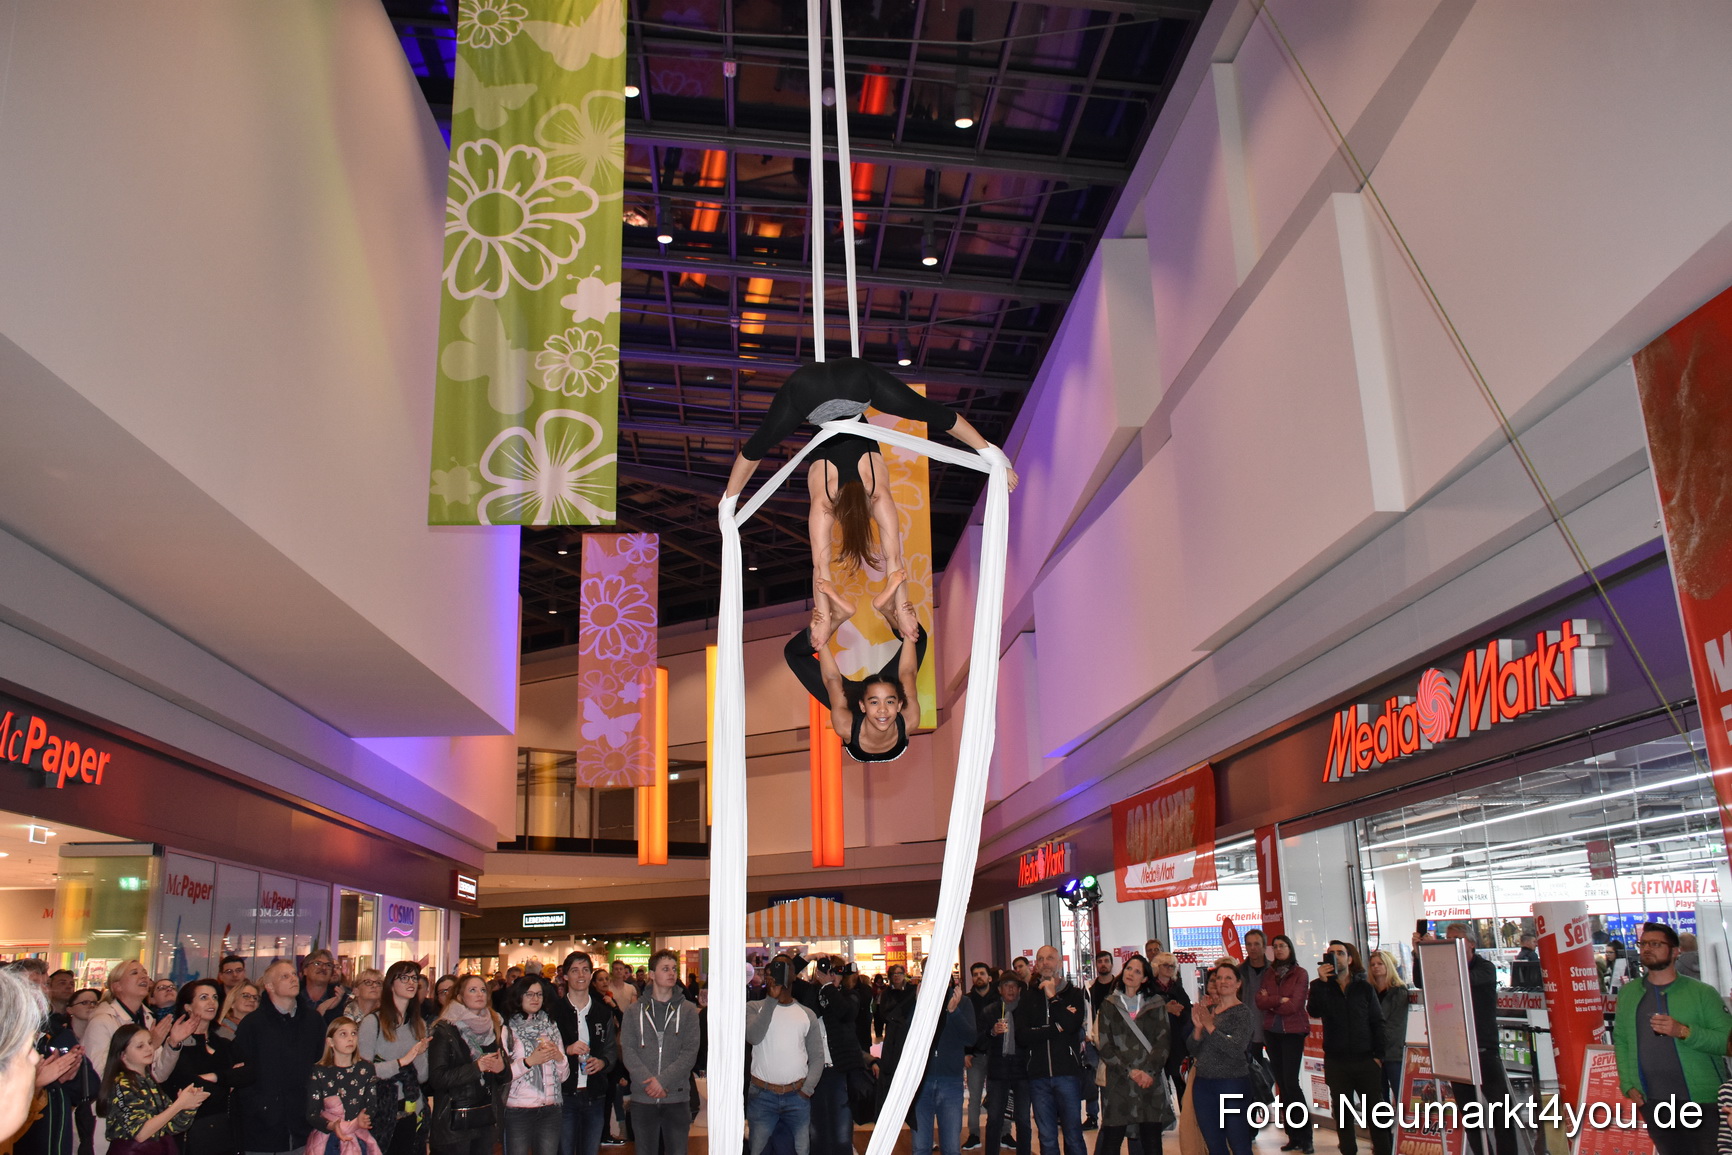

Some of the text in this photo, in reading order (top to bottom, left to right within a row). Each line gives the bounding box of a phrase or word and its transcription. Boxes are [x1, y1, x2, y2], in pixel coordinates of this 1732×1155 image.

[1322, 694, 1421, 783] Media
[1448, 619, 1582, 739] Markt
[1018, 842, 1066, 888] Media Markt
[1261, 836, 1275, 893] 1
[1141, 862, 1175, 884] Media Markt
[166, 873, 214, 904] McPaper
[1423, 888, 1436, 902] M
[1630, 879, 1699, 895] SOFTWARE
[261, 890, 296, 911] McPaper
[388, 903, 415, 925] COSMO
[525, 915, 564, 925] LEBENSRAUM
[1425, 909, 1447, 918] u-ray
[887, 951, 906, 961] ALLES
[1569, 965, 1592, 978] Strom
[1572, 981, 1587, 991] bei
[1497, 995, 1513, 1008] edia
[1519, 993, 1542, 1009] Markt
